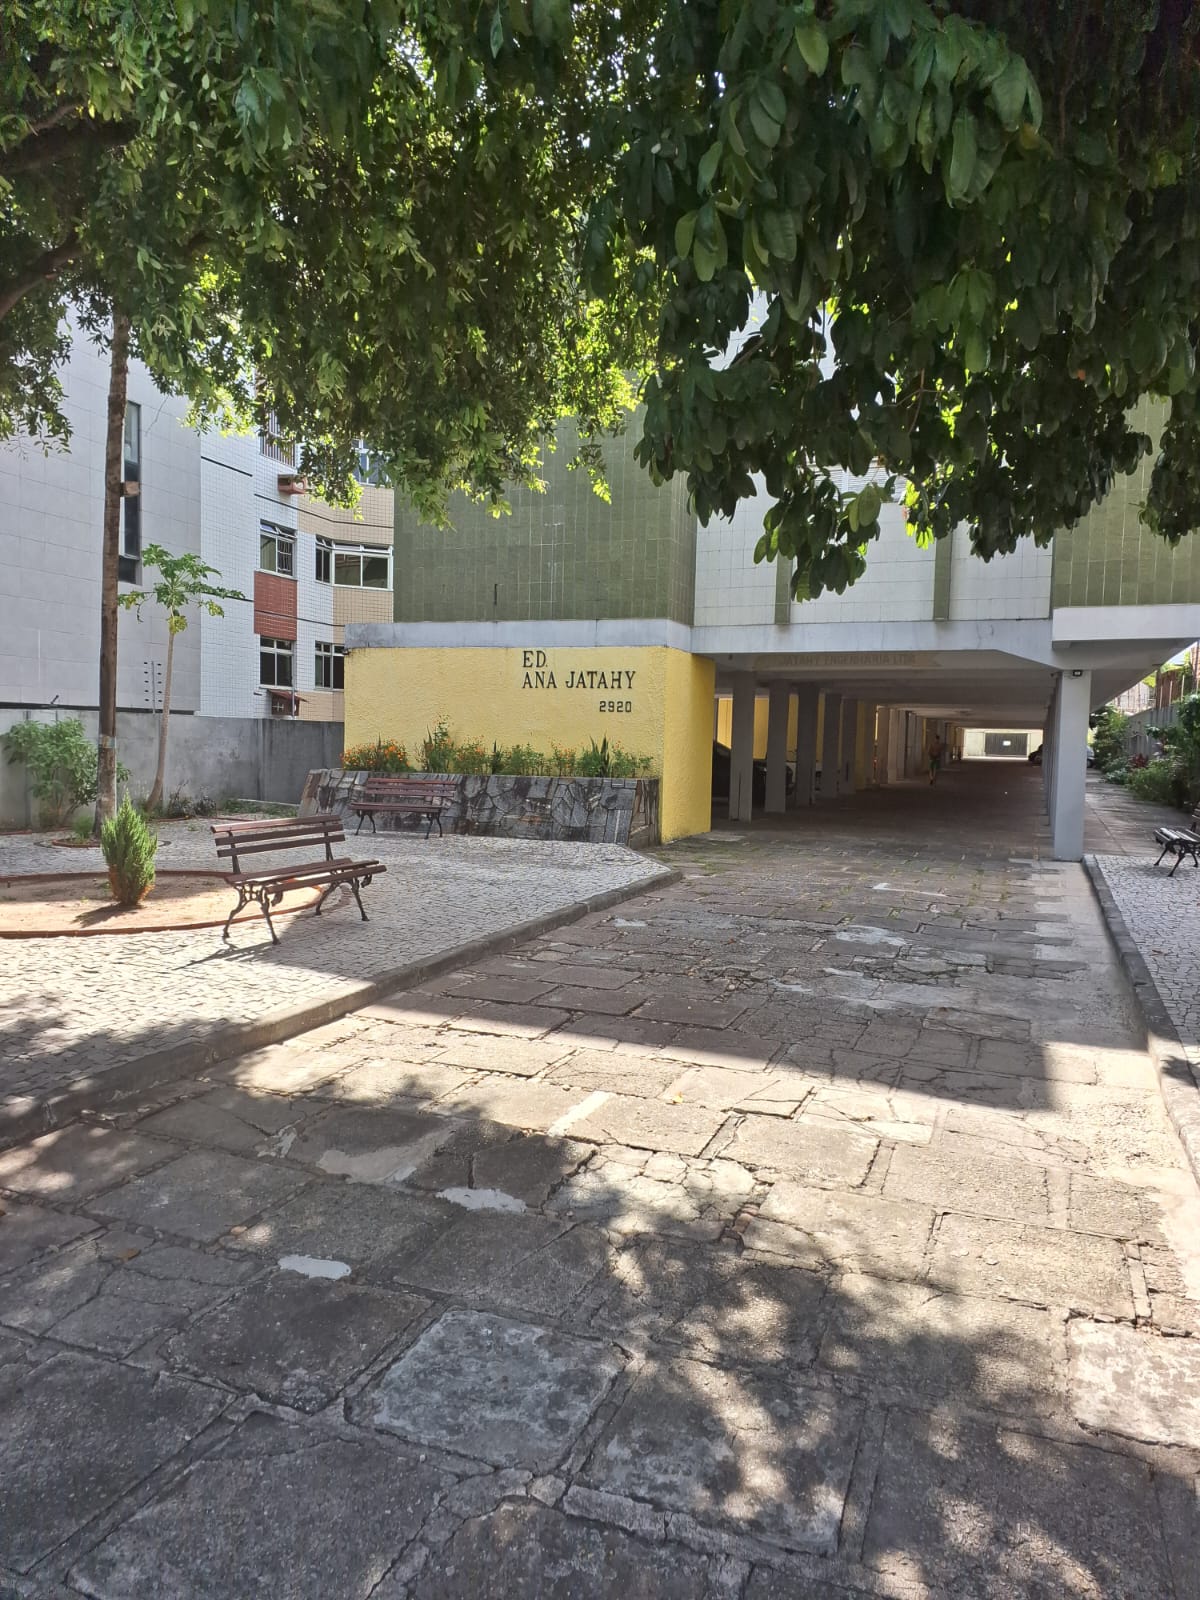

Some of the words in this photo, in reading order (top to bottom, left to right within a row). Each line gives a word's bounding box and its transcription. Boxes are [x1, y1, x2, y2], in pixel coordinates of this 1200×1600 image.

[522, 671, 558, 689] ANA
[565, 670, 636, 689] JATAHY
[599, 700, 632, 713] 2920
